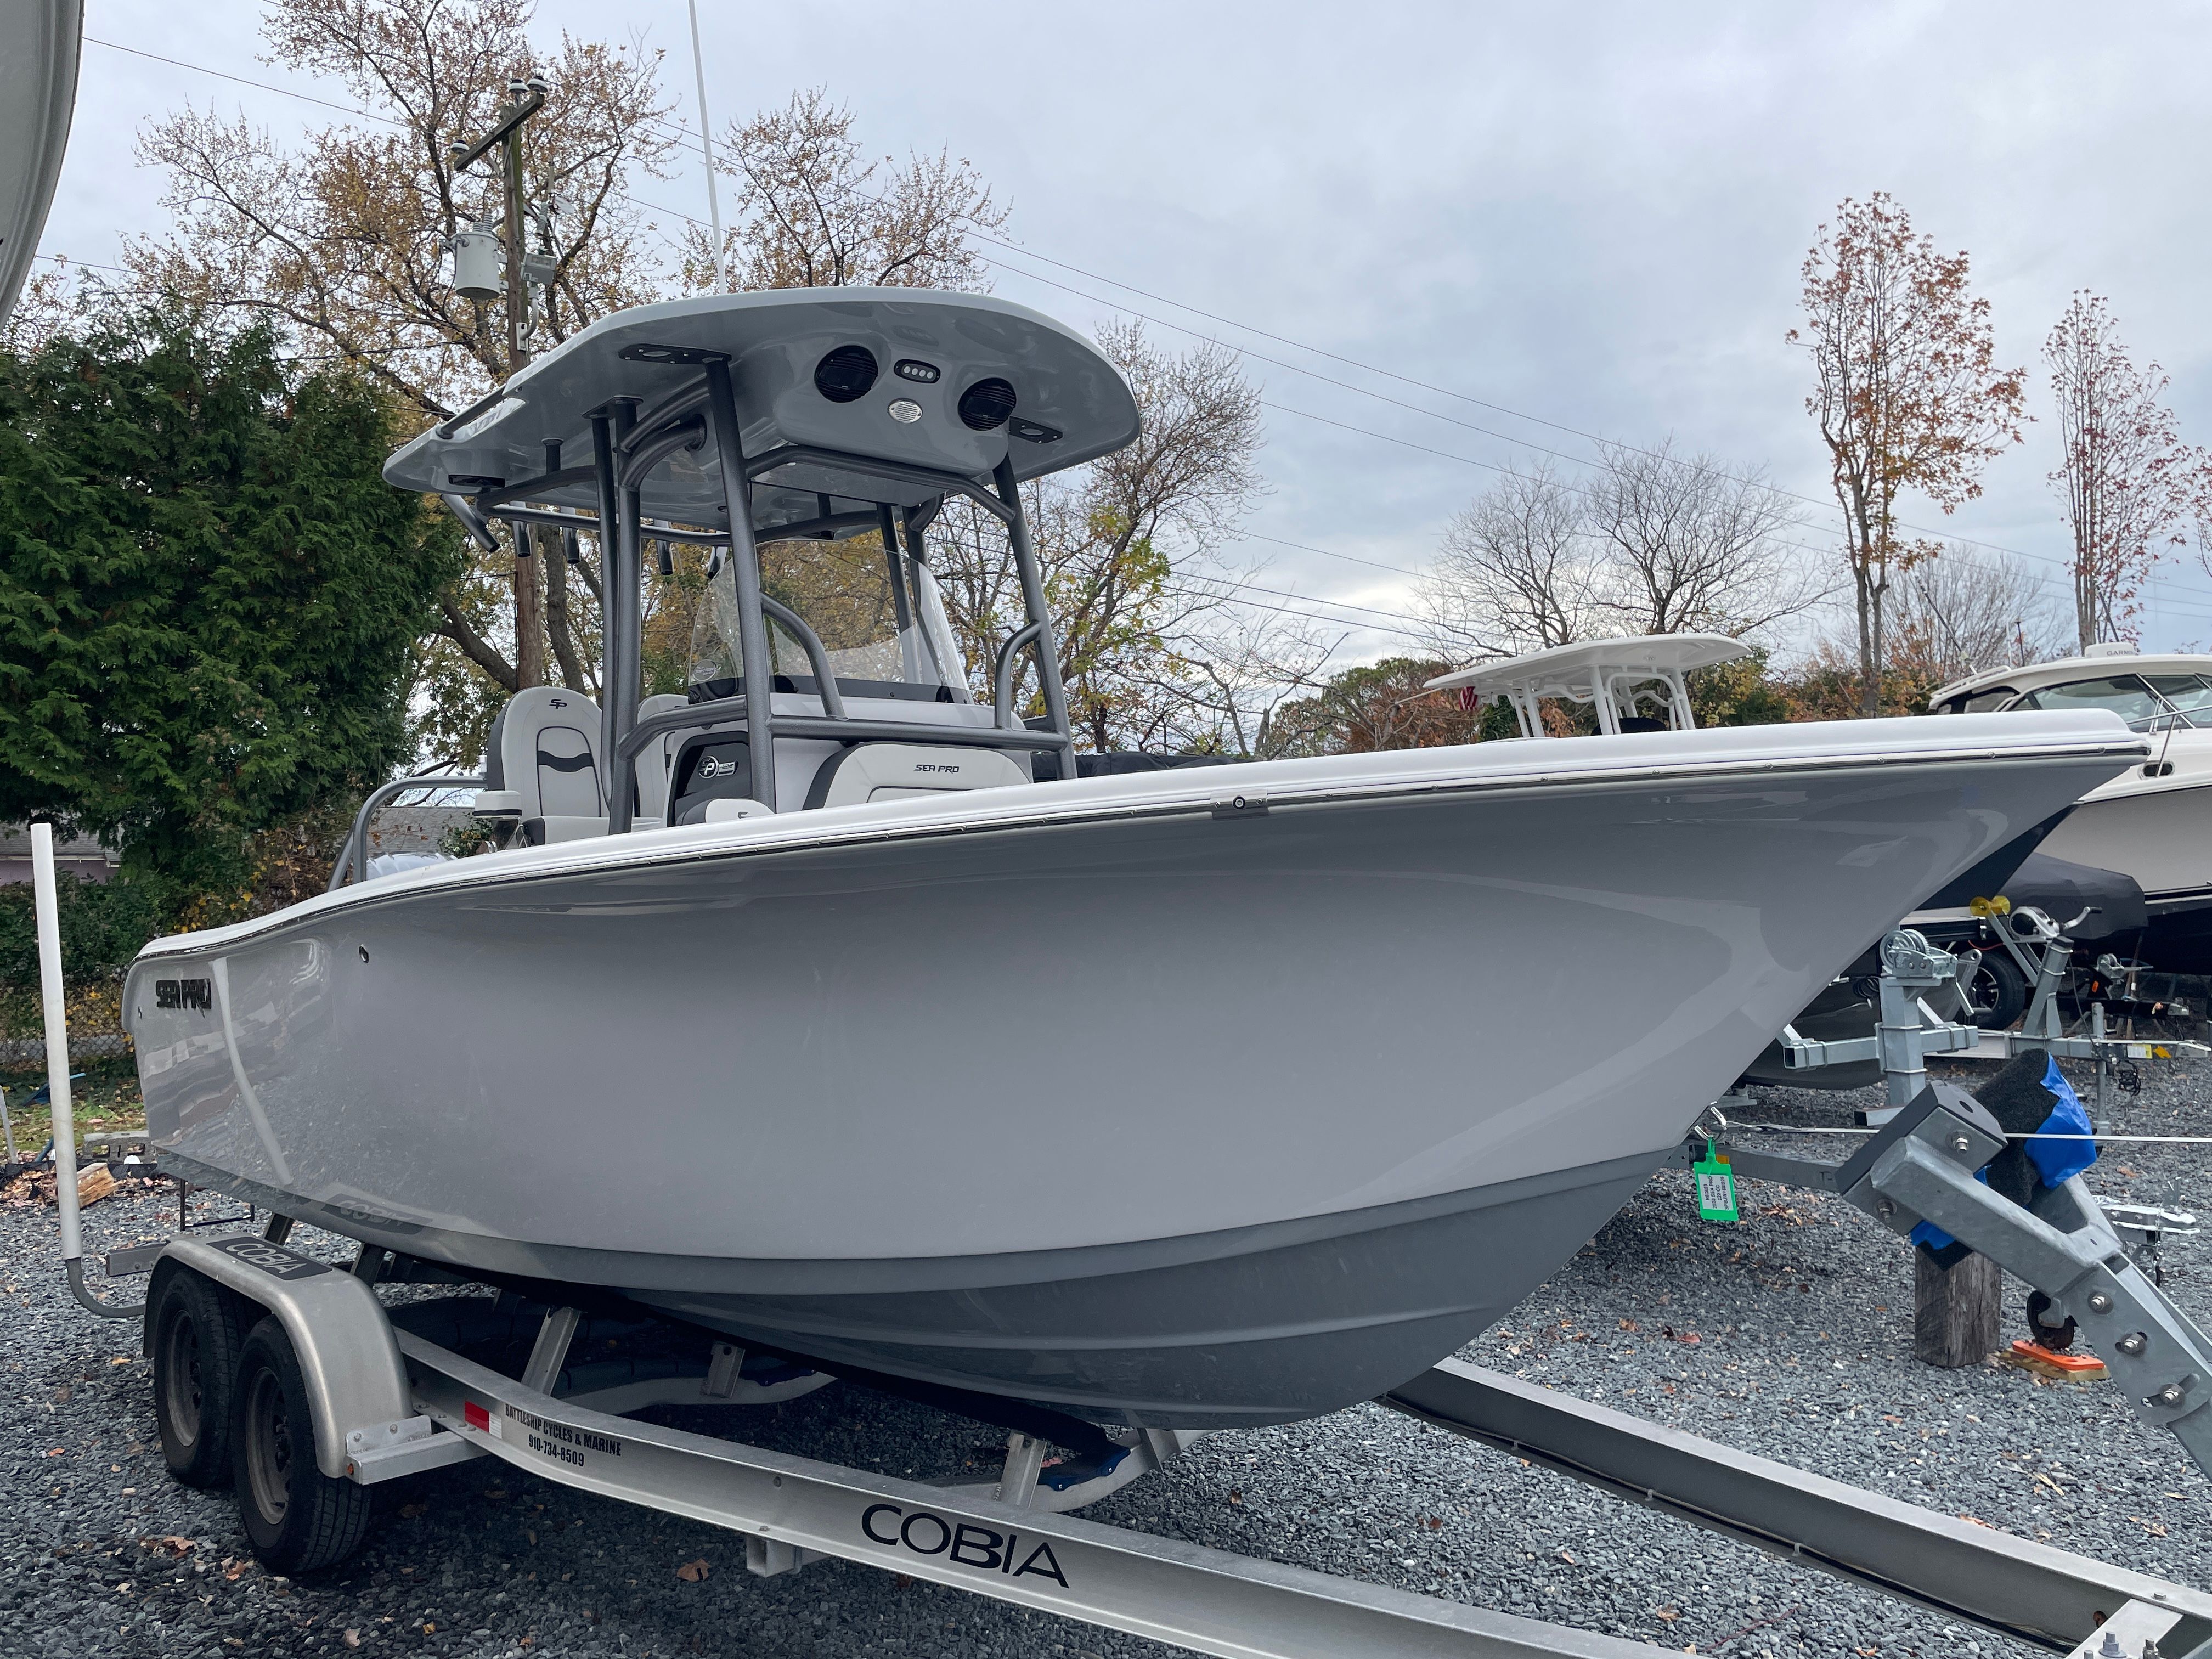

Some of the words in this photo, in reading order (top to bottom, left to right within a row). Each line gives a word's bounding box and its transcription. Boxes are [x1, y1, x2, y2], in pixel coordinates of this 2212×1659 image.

[938, 765, 960, 774] PRO
[156, 980, 181, 1008] SEA
[225, 1243, 307, 1274] COBIA
[505, 1403, 542, 1431] BATTLESHIP
[543, 1423, 573, 1443] CYCLES
[575, 1434, 582, 1446] &
[584, 1435, 622, 1457] MARINE
[528, 1434, 585, 1466] 910-734-8509
[861, 1504, 1070, 1589] COBIA
